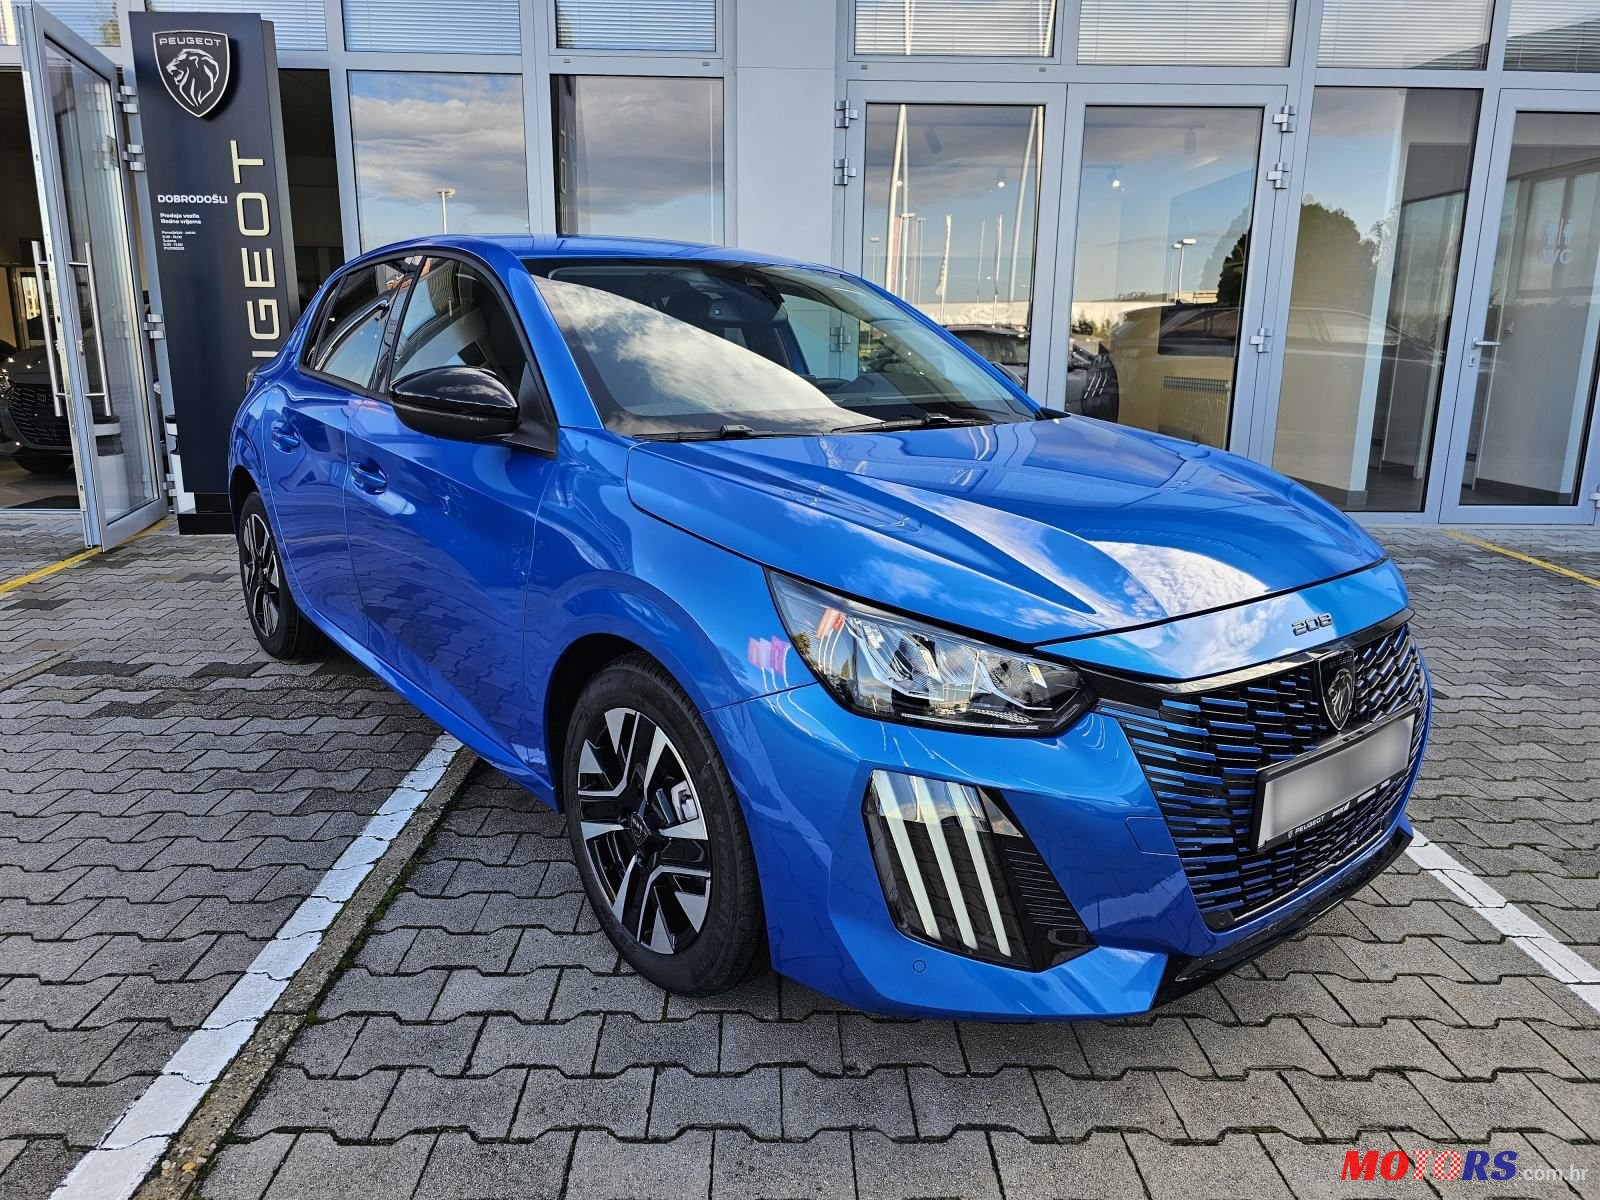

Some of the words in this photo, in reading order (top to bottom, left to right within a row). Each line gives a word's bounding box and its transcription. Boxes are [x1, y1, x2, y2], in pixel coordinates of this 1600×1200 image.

[159, 37, 222, 47] PEUGEOT
[157, 193, 228, 204] DOBRODOŠLI
[1542, 248, 1573, 265] WC
[1295, 815, 1326, 834] PEUGEOT
